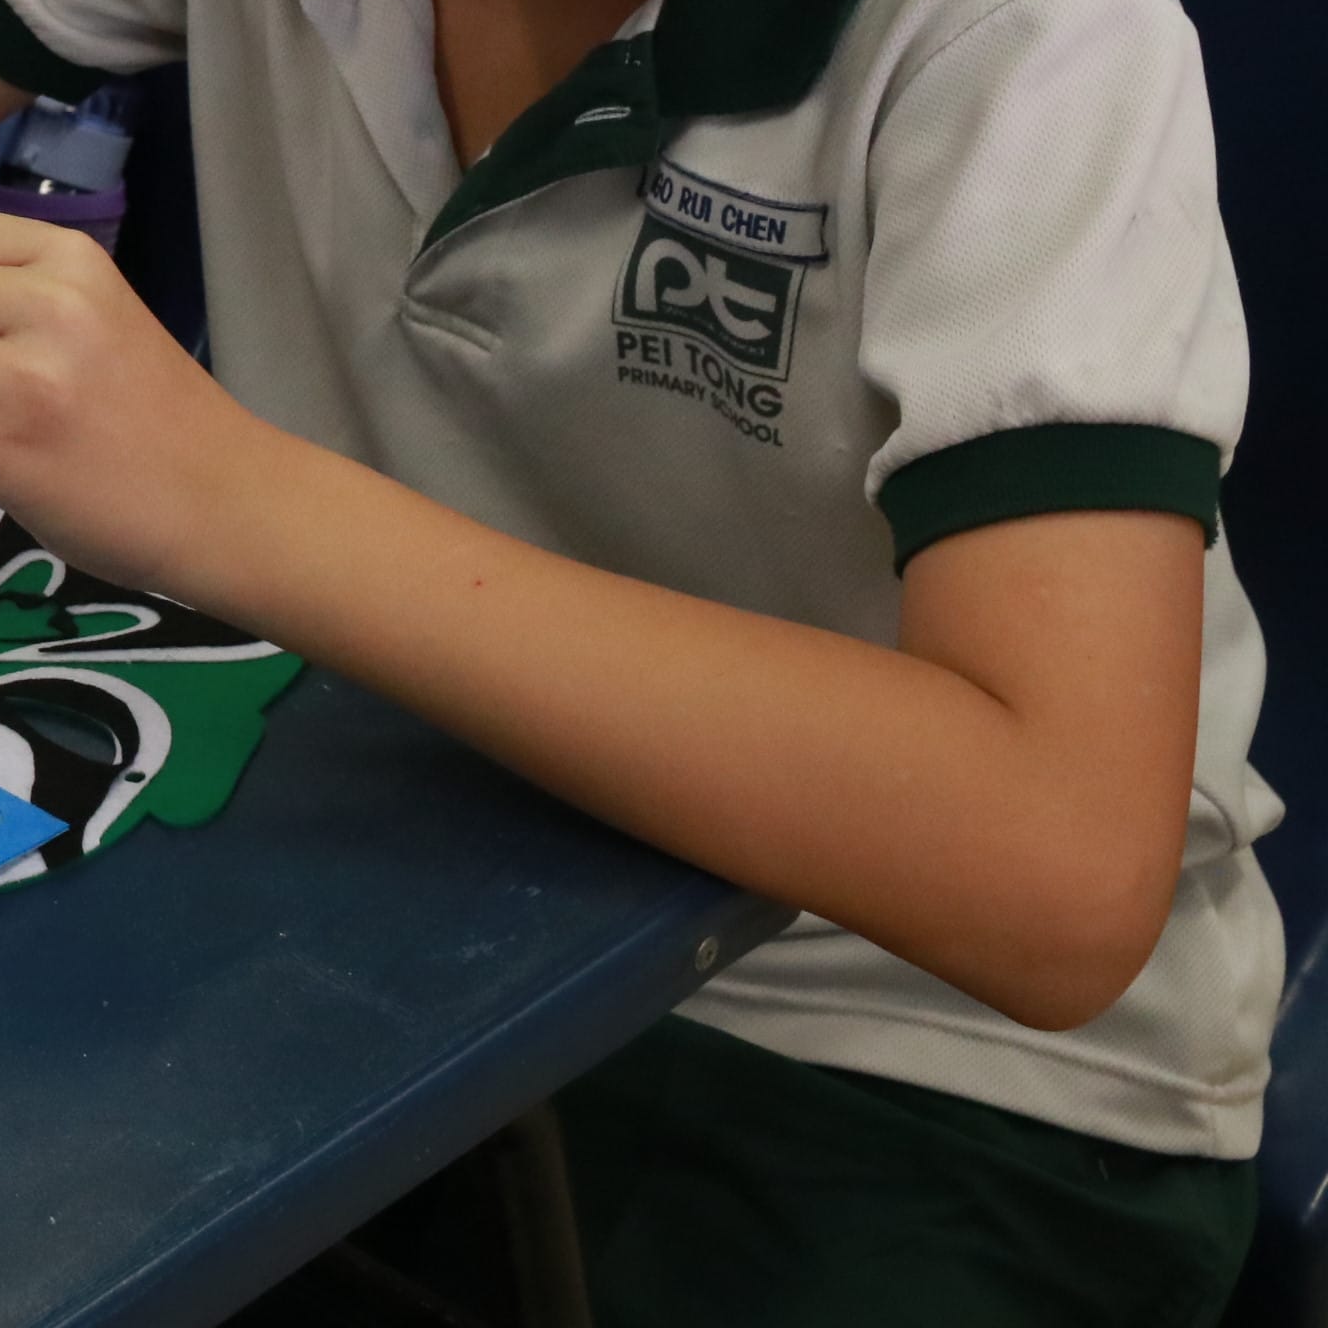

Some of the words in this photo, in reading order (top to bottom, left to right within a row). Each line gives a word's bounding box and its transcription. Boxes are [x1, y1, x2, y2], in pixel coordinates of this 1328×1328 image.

[677, 190, 713, 222] RUI
[721, 205, 788, 245] CHEN
[616, 332, 672, 365] PEI
[685, 340, 784, 418] TONG
[617, 365, 706, 402] PRIMARY
[710, 392, 784, 447] SCHOOL
